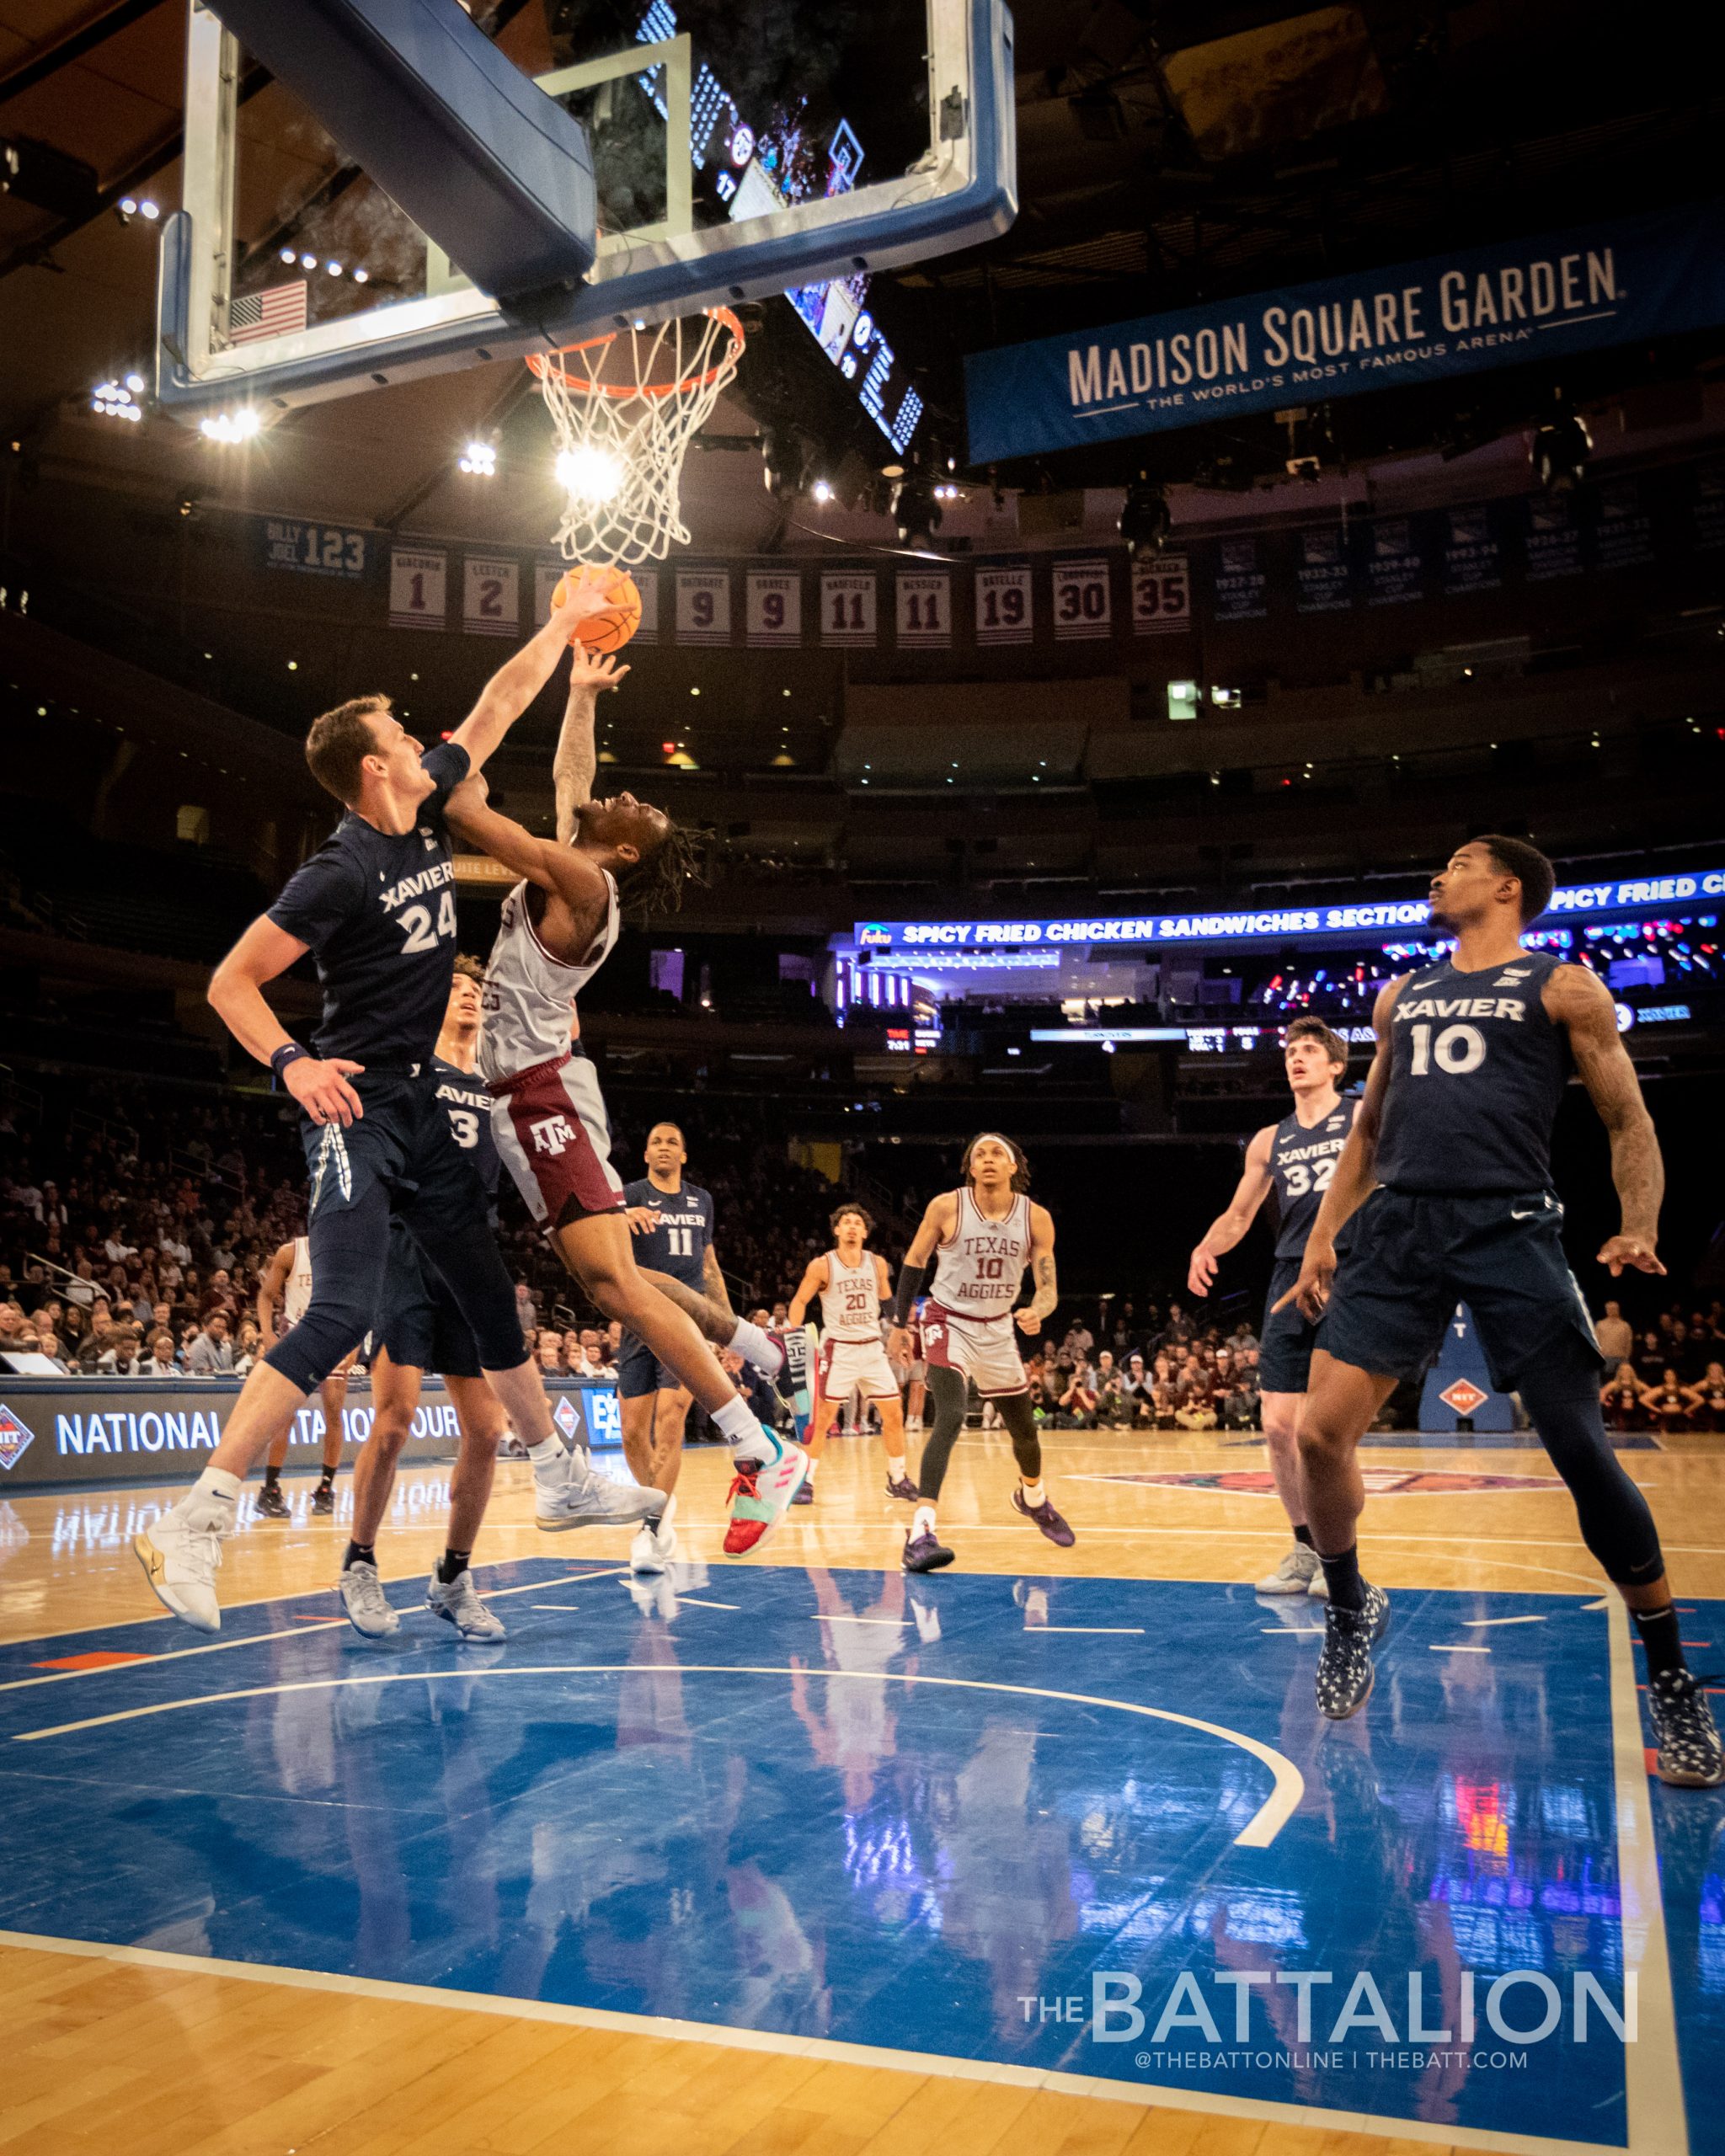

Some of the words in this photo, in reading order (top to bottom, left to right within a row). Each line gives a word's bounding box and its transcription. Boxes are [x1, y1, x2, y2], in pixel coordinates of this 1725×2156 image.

[1068, 323, 1248, 406] MADISON
[1263, 286, 1425, 366] SQUARE
[1440, 248, 1616, 332] GARDEN
[1147, 394, 1184, 410] THE
[1192, 375, 1284, 402] WORLD'S
[1292, 362, 1349, 383] MOST
[1359, 344, 1447, 371] FAMOUS
[304, 528, 365, 572] 123
[410, 573, 425, 611] 1
[479, 579, 503, 616] 2
[692, 591, 714, 628] 9
[984, 588, 1024, 627] 19
[1058, 583, 1106, 621] 30
[1137, 577, 1185, 616] 35
[763, 593, 785, 630] 9
[832, 593, 866, 630] 11
[906, 593, 940, 630] 11
[379, 862, 456, 914] XAVIER
[1549, 885, 1612, 911] PICY
[1616, 878, 1697, 904] FRIED
[396, 890, 457, 954] 24
[859, 930, 892, 945] fuku
[902, 926, 971, 943] SPICY
[974, 923, 1042, 942] FRIED
[1044, 921, 1154, 942] CHICKEN
[1159, 912, 1319, 937] SANDWICHES
[1393, 998, 1527, 1022] XAVIER
[1410, 1023, 1487, 1075] 10
[434, 1085, 494, 1112] AVIE
[447, 1109, 478, 1149] 3
[1277, 1139, 1346, 1166] XAVIER
[1283, 1158, 1338, 1196] 32
[652, 1214, 706, 1227] AVIER
[667, 1228, 693, 1257] 11
[964, 1236, 1020, 1257] TEXAS
[836, 1278, 873, 1294] TEXAS
[975, 1257, 1003, 1279] 10
[846, 1293, 867, 1310] 20
[957, 1283, 1015, 1299] AGGIES
[839, 1311, 873, 1326] AGGIES
